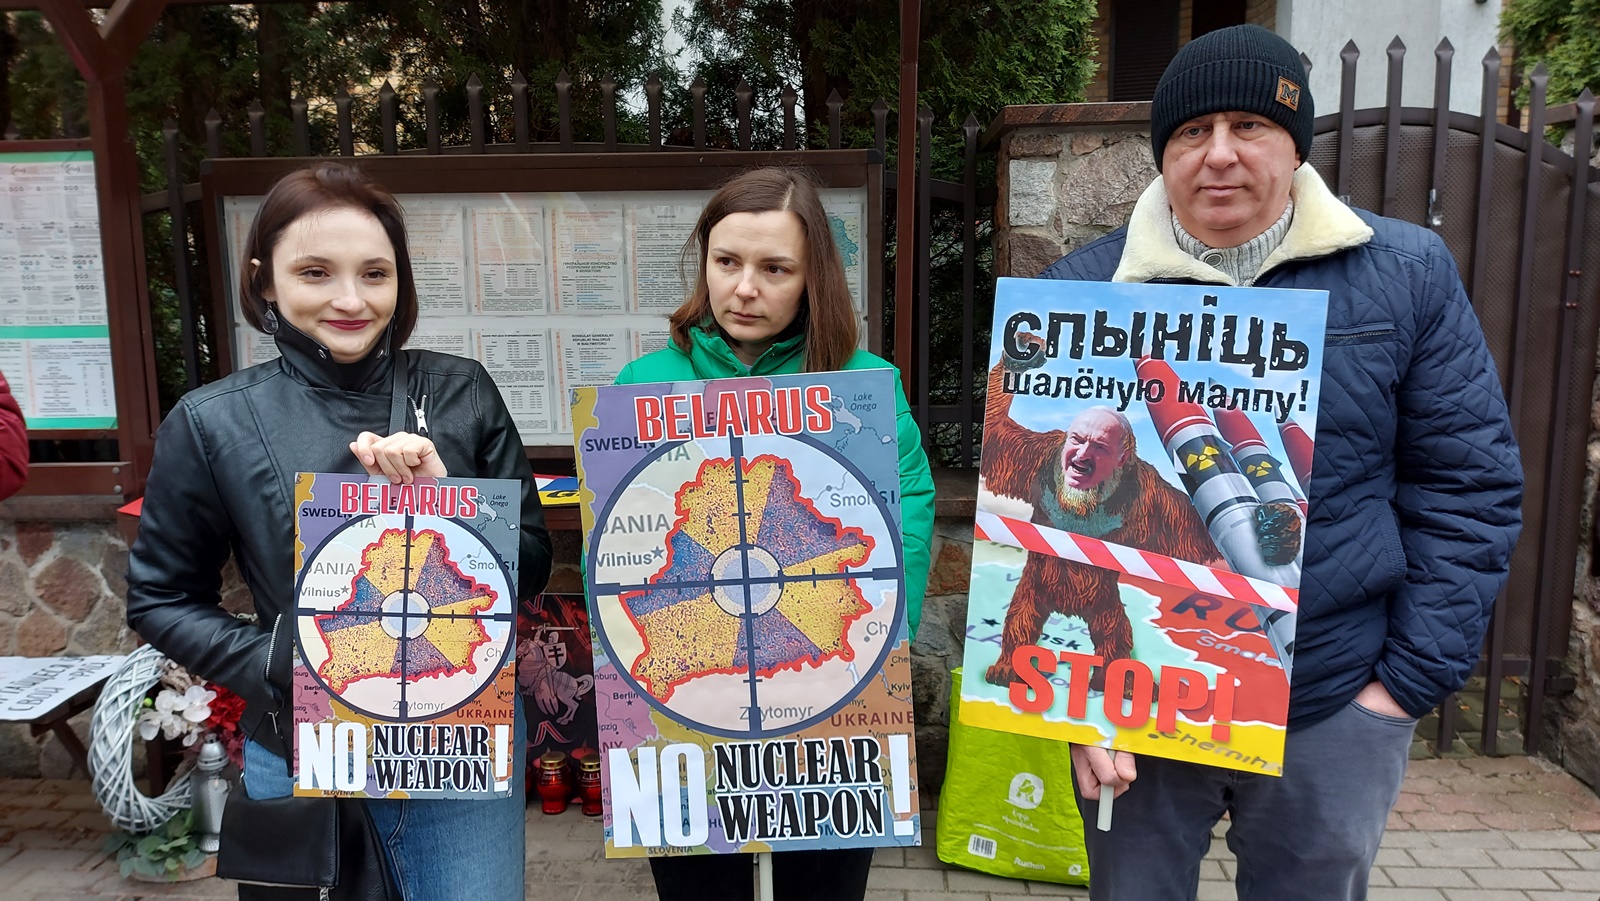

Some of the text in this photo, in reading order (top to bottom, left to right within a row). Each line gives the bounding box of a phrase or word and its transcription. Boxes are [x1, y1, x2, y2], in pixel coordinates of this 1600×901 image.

[1280, 83, 1299, 105] M
[853, 393, 873, 401] Lake
[1002, 367, 1310, 424] шалёную малпу!
[634, 385, 832, 443] BELARUS
[340, 482, 479, 518] BELARUS
[596, 551, 653, 568] Vilnius
[300, 586, 341, 598] Vilnius
[612, 692, 639, 701] Berlin
[891, 684, 911, 693] Kyiv
[1009, 645, 1237, 743] STOP!
[392, 700, 445, 712] Zytomyr
[739, 704, 814, 722] Zytomyr
[831, 711, 914, 728] UKRAINE
[373, 725, 490, 757] NUCLEAR
[299, 722, 367, 792] NO
[714, 737, 884, 791] NUCLEAR
[373, 758, 489, 793] WEAPON
[608, 742, 709, 849] NO
[716, 788, 888, 843] WEAPON
[648, 846, 694, 855] SLOVENIA
[1014, 857, 1046, 870] Auchan
